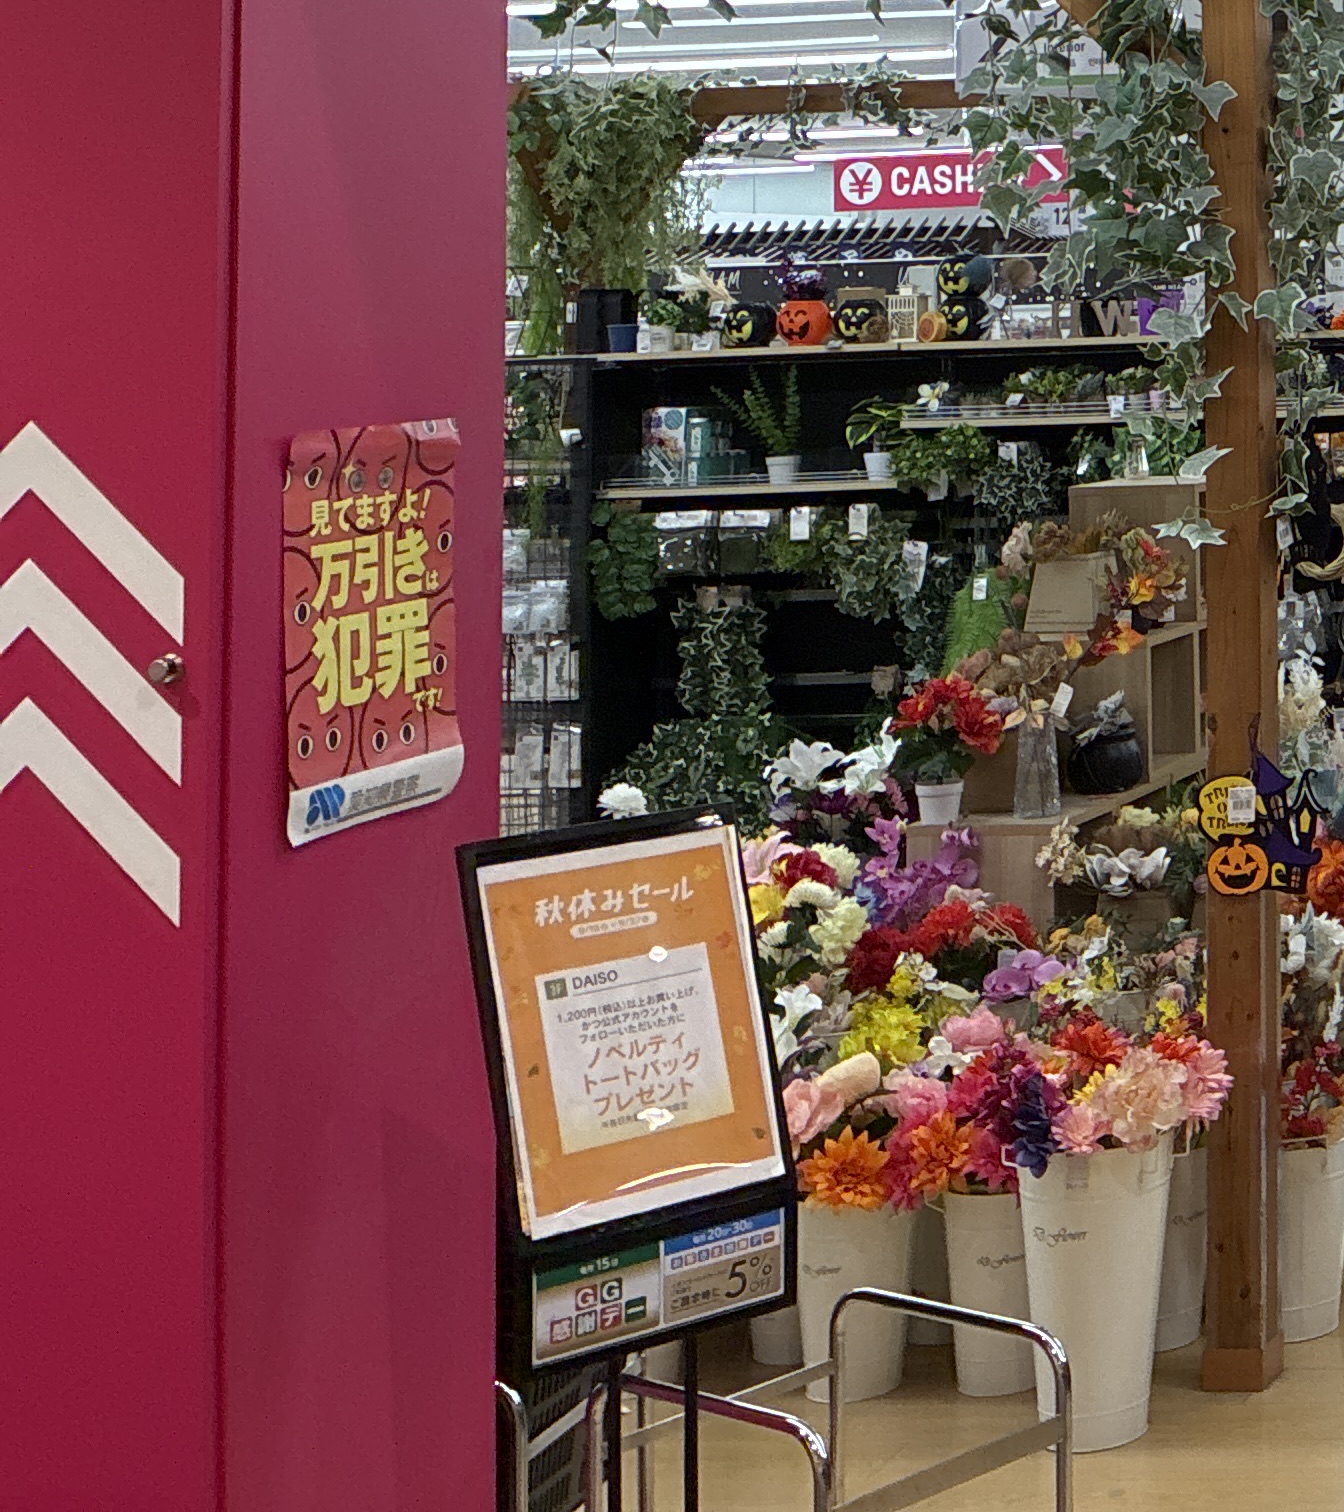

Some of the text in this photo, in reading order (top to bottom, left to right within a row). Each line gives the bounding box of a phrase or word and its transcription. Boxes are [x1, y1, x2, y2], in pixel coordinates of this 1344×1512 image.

[1043, 41, 1086, 53] Inerior
[891, 164, 985, 196] CASH
[1090, 300, 1134, 336] W
[309, 487, 431, 538] 見てますよ!
[1204, 787, 1228, 805] TRI
[1217, 802, 1227, 814] O
[535, 876, 694, 927] 秋休みセール
[572, 969, 618, 989] DAISO
[580, 1013, 686, 1044] フォローいただいた方に
[582, 1002, 678, 1031] かつ公式アカウントを
[588, 1032, 685, 1069] ノベルティ
[584, 1048, 700, 1095] トートバッグ
[594, 1077, 694, 1116] プレゼント
[749, 1276, 772, 1292] OFF
[552, 1305, 645, 1344] 感謝デー
